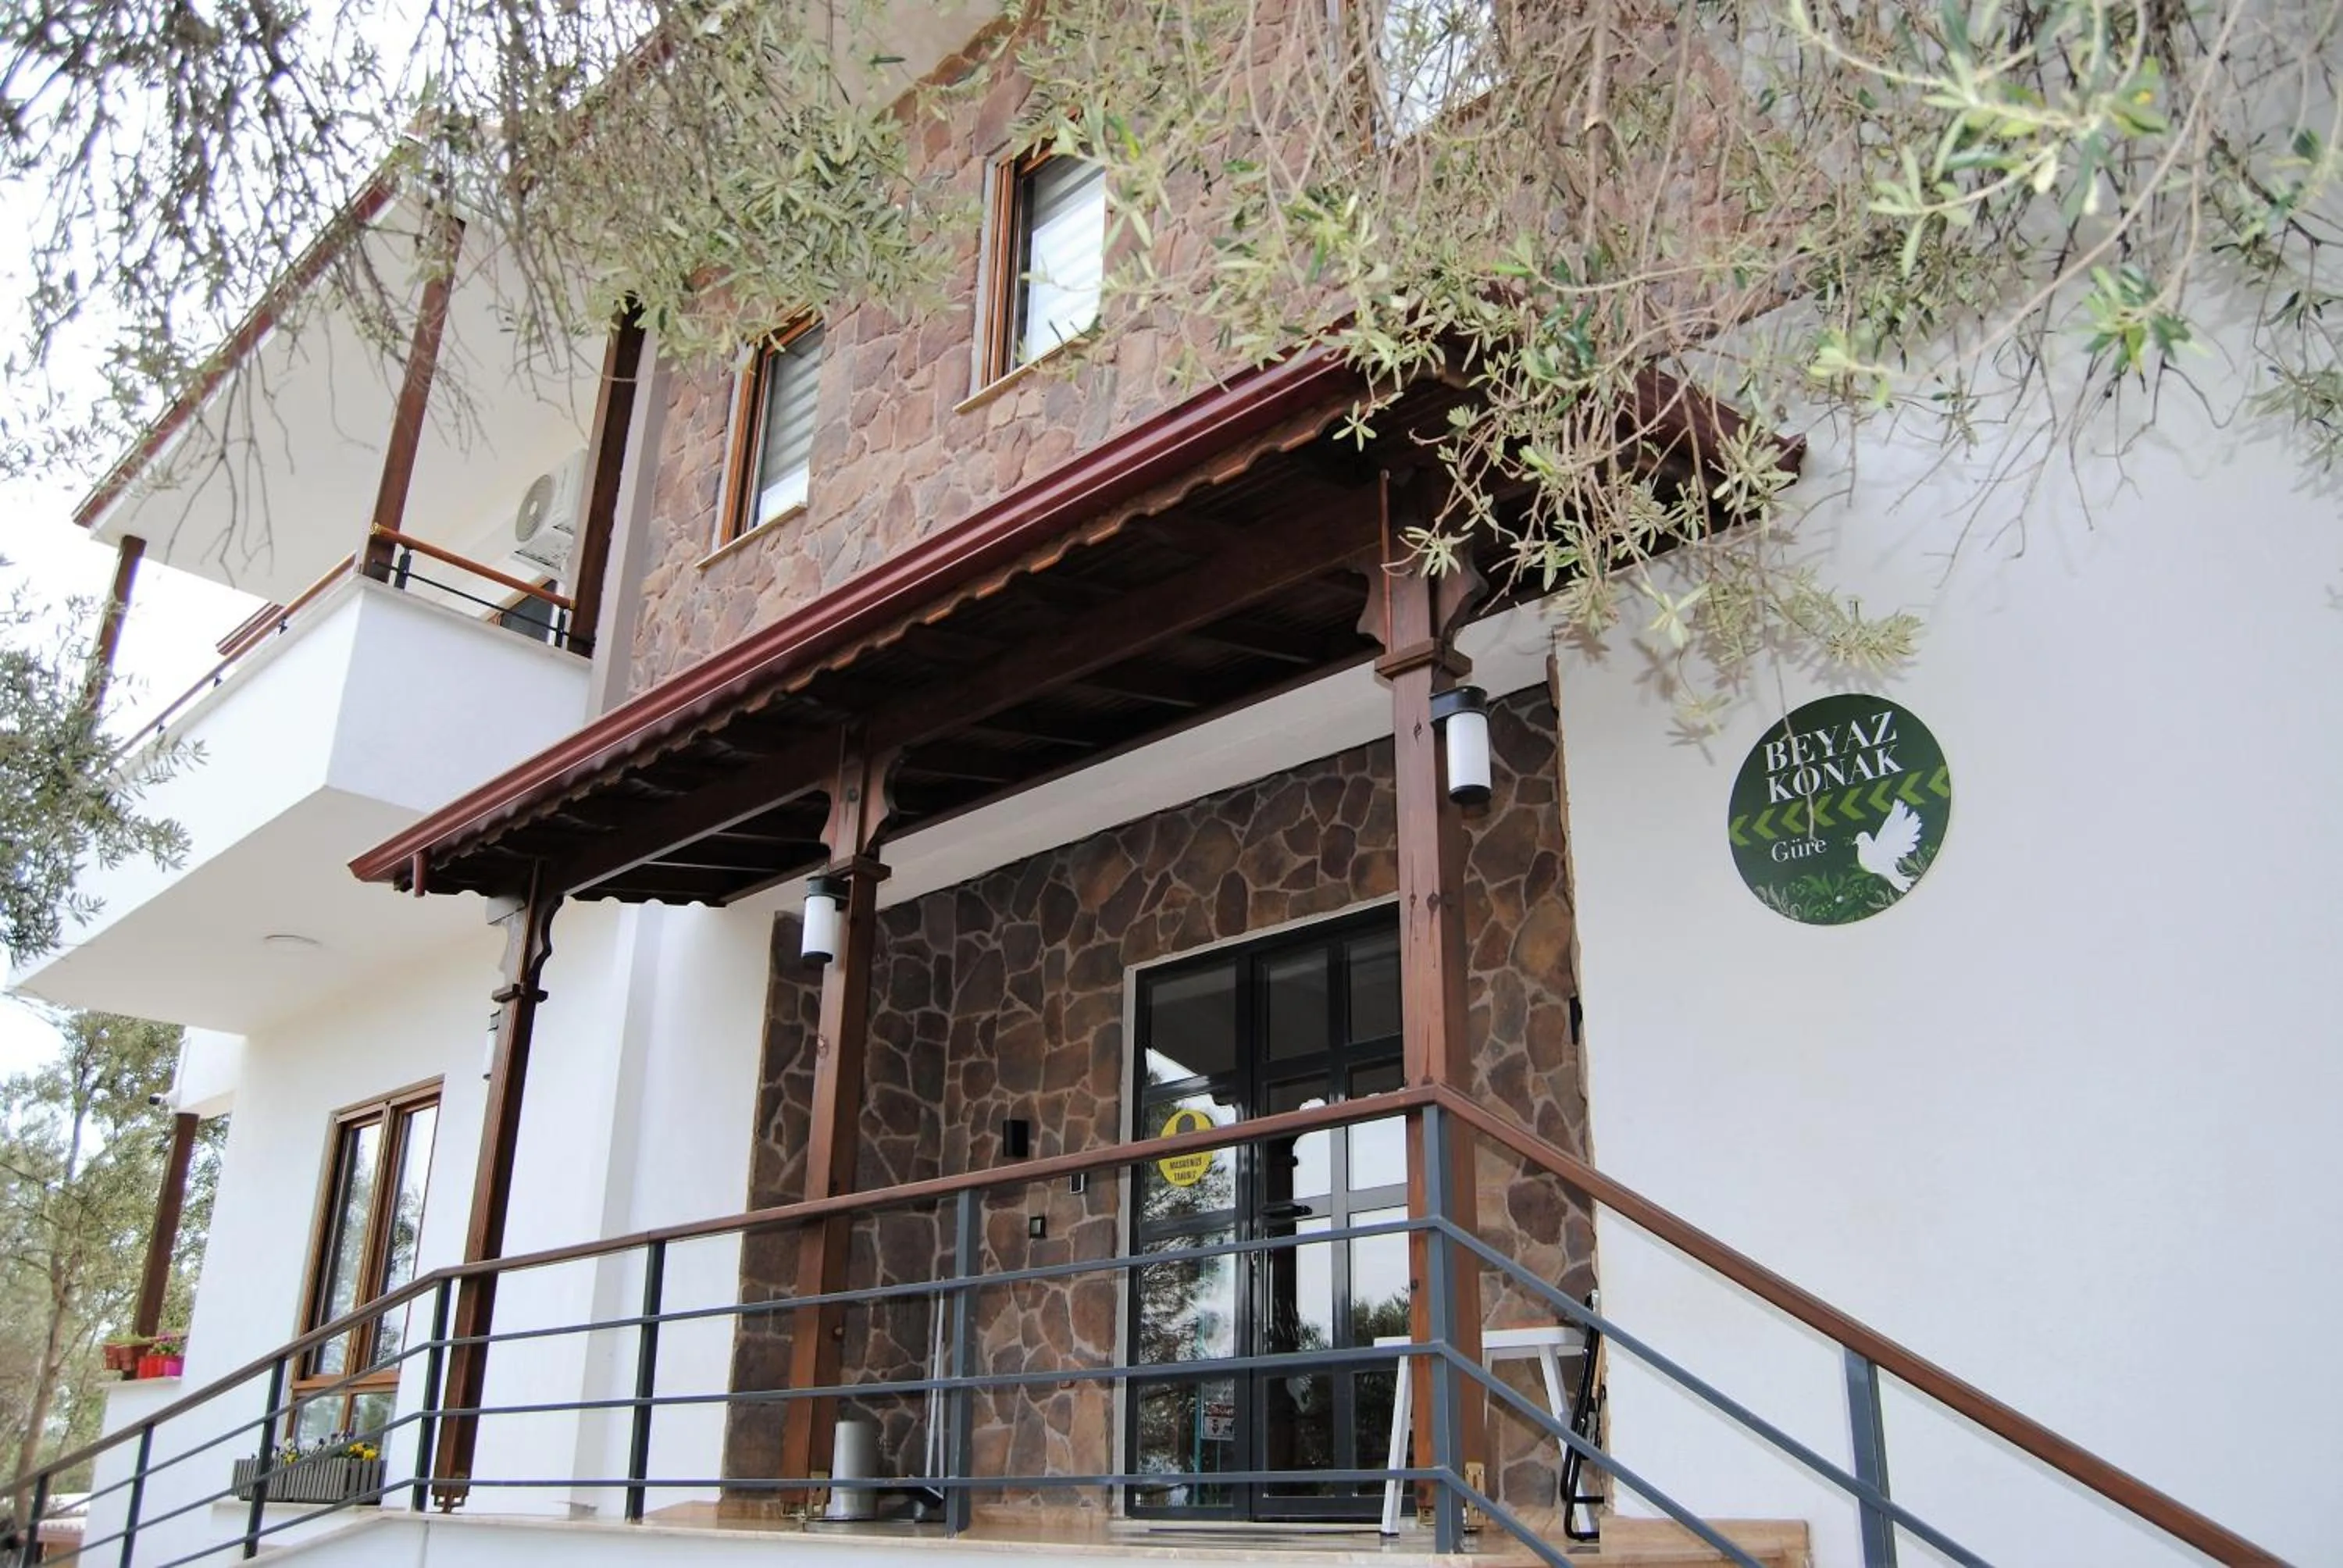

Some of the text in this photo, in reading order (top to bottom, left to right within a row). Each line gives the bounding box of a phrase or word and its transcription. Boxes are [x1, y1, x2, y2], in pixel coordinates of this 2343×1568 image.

[1763, 711, 1897, 772] BEYAZ
[1766, 744, 1903, 804] KONAK
[1771, 836, 1828, 862] Güre
